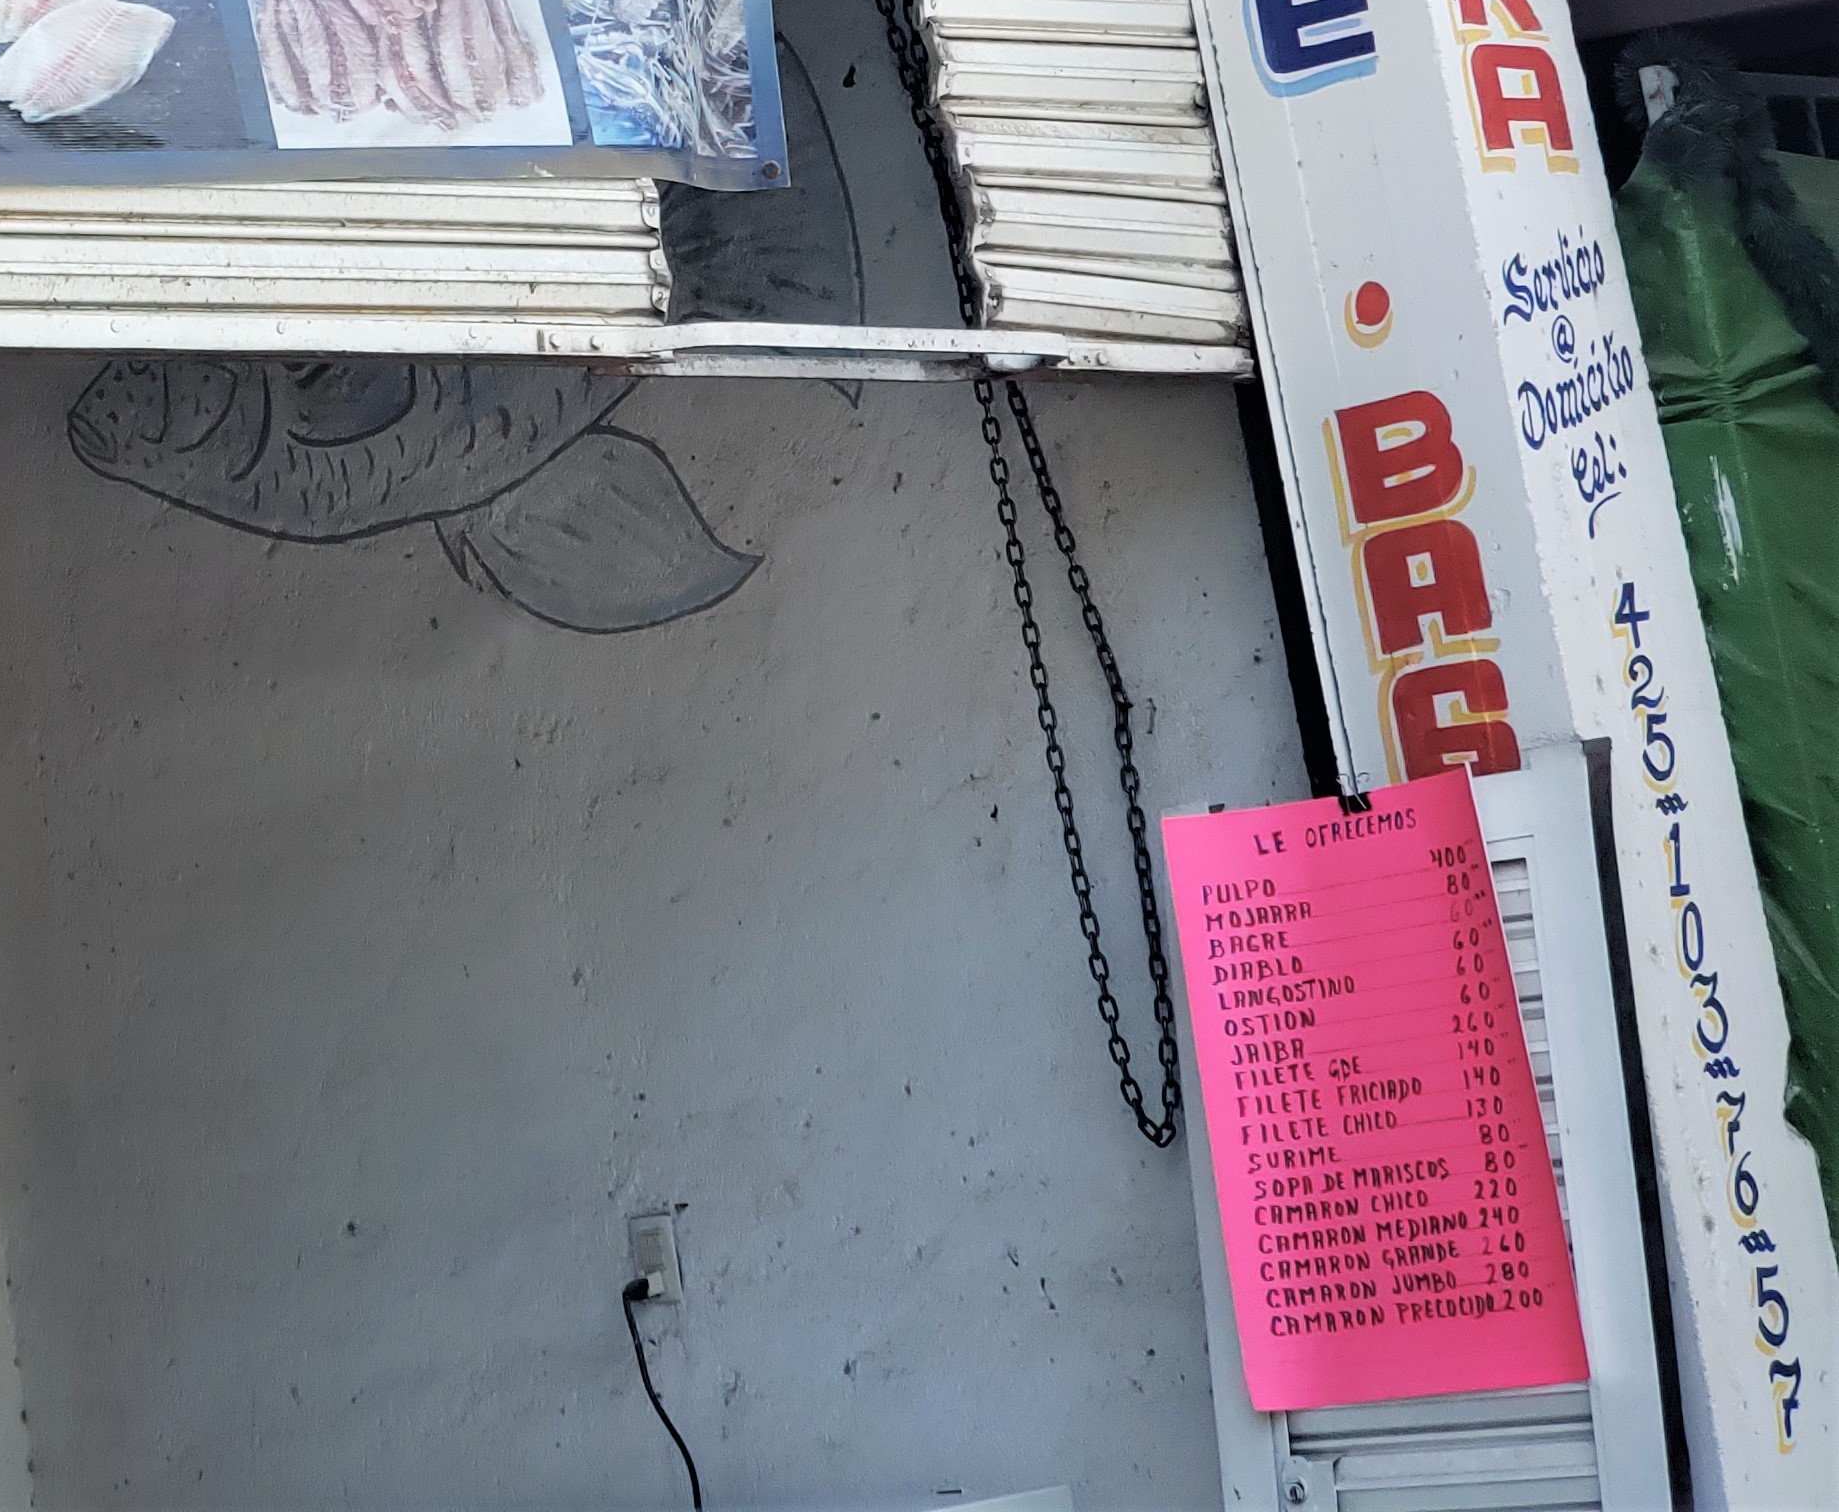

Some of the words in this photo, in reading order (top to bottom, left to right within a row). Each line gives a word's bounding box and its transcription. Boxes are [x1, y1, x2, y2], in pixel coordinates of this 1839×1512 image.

[1517, 329, 1634, 451] Domicilio
[1253, 830, 1288, 856] LE
[1304, 807, 1418, 849] OFRECEMOS
[1201, 878, 1276, 906] PULPO
[1428, 845, 1467, 868] 400
[1205, 901, 1312, 932] MOJARRA
[1446, 871, 1471, 895] 80
[1208, 931, 1290, 960] BAGRE
[1212, 955, 1304, 986] DIABLO
[1453, 927, 1480, 951] 60
[1217, 975, 1356, 1011] LANGOSTINO
[1456, 952, 1485, 976] 60
[1223, 1007, 1316, 1037] OSTION
[1460, 981, 1490, 1005] 60
[1230, 1038, 1305, 1066] JAIBA
[1452, 1010, 1495, 1034] 260
[1234, 1062, 1316, 1091] FILETE
[1457, 1037, 1495, 1061] 140
[1237, 1088, 1323, 1119] FILETE
[1462, 1065, 1501, 1090] 140
[1240, 1117, 1330, 1146] FILETE
[1342, 1110, 1398, 1138] CHICO
[1465, 1095, 1504, 1120] 130
[1247, 1145, 1341, 1175] SURIME
[1478, 1122, 1510, 1146] 80
[1253, 1175, 1314, 1202] SOPA
[1321, 1171, 1346, 1195] DE
[1351, 1157, 1451, 1189] MARISCOS
[1484, 1149, 1516, 1174] 80
[1254, 1196, 1359, 1226] CAMARON
[1370, 1189, 1429, 1214] CHICO
[1473, 1176, 1518, 1200] 220
[1258, 1224, 1366, 1255] CAMARON
[1375, 1210, 1468, 1243] MEDIANO
[1478, 1205, 1520, 1229] 240
[1260, 1250, 1371, 1282] CAMARON
[1382, 1239, 1461, 1271] GRANDE
[1482, 1230, 1526, 1256] 260
[1265, 1279, 1377, 1309] CAMARON
[1392, 1270, 1458, 1295] JUMBO
[1485, 1260, 1530, 1285] 280
[1270, 1303, 1386, 1337] CAMARON
[1394, 1291, 1495, 1325] PRECOCIDO
[1502, 1287, 1544, 1311] 200
